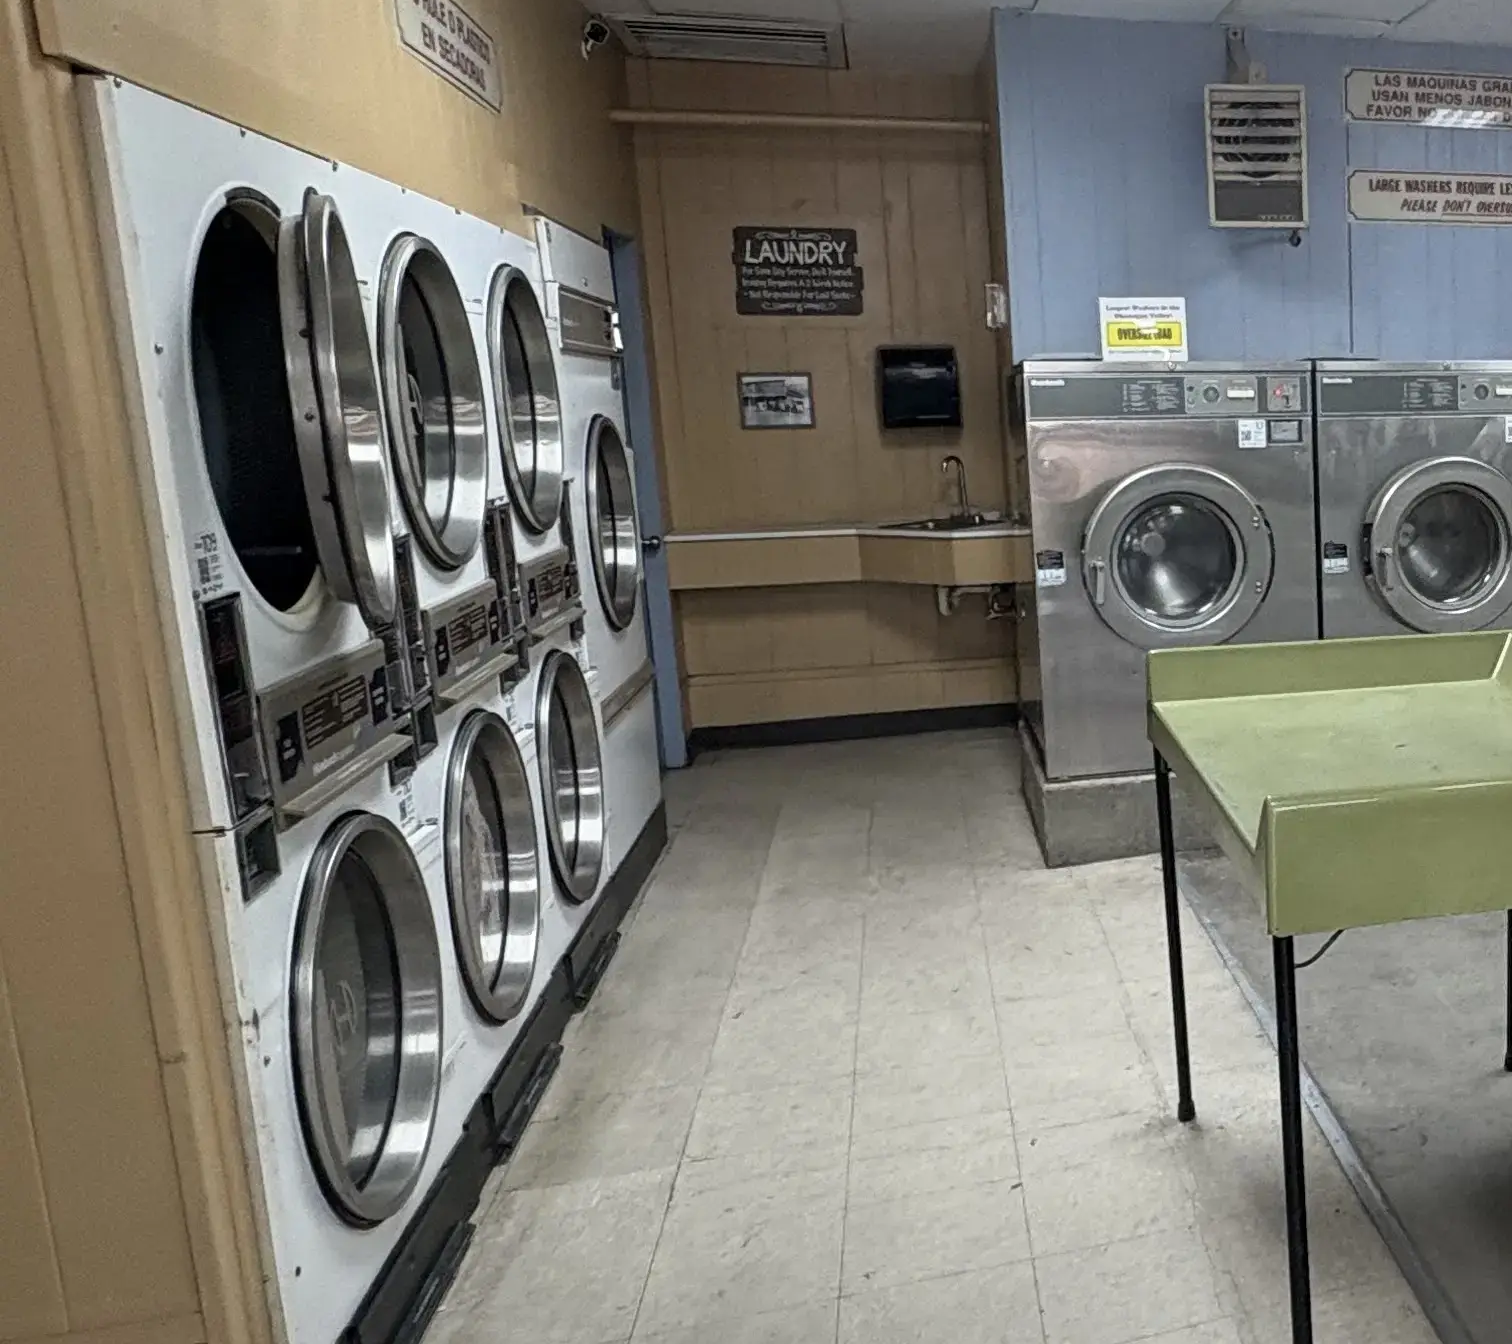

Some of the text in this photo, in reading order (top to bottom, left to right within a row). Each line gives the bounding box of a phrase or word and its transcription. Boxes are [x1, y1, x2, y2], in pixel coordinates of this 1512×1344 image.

[421, 22, 436, 52] EN
[1374, 74, 1401, 88] LAS
[1407, 76, 1477, 92] MAQUINAS
[1371, 90, 1409, 103] USAN
[1415, 93, 1463, 105] MENOS
[1366, 104, 1412, 118] FAVOR
[1417, 107, 1437, 119] NO
[1368, 178, 1402, 193] LARGE
[1404, 179, 1453, 195] WASHERS
[1456, 181, 1495, 196] REQUIRE
[1400, 198, 1437, 212] PLEASE
[1442, 199, 1471, 213] DON'T
[744, 239, 847, 266] LAUNDRY
